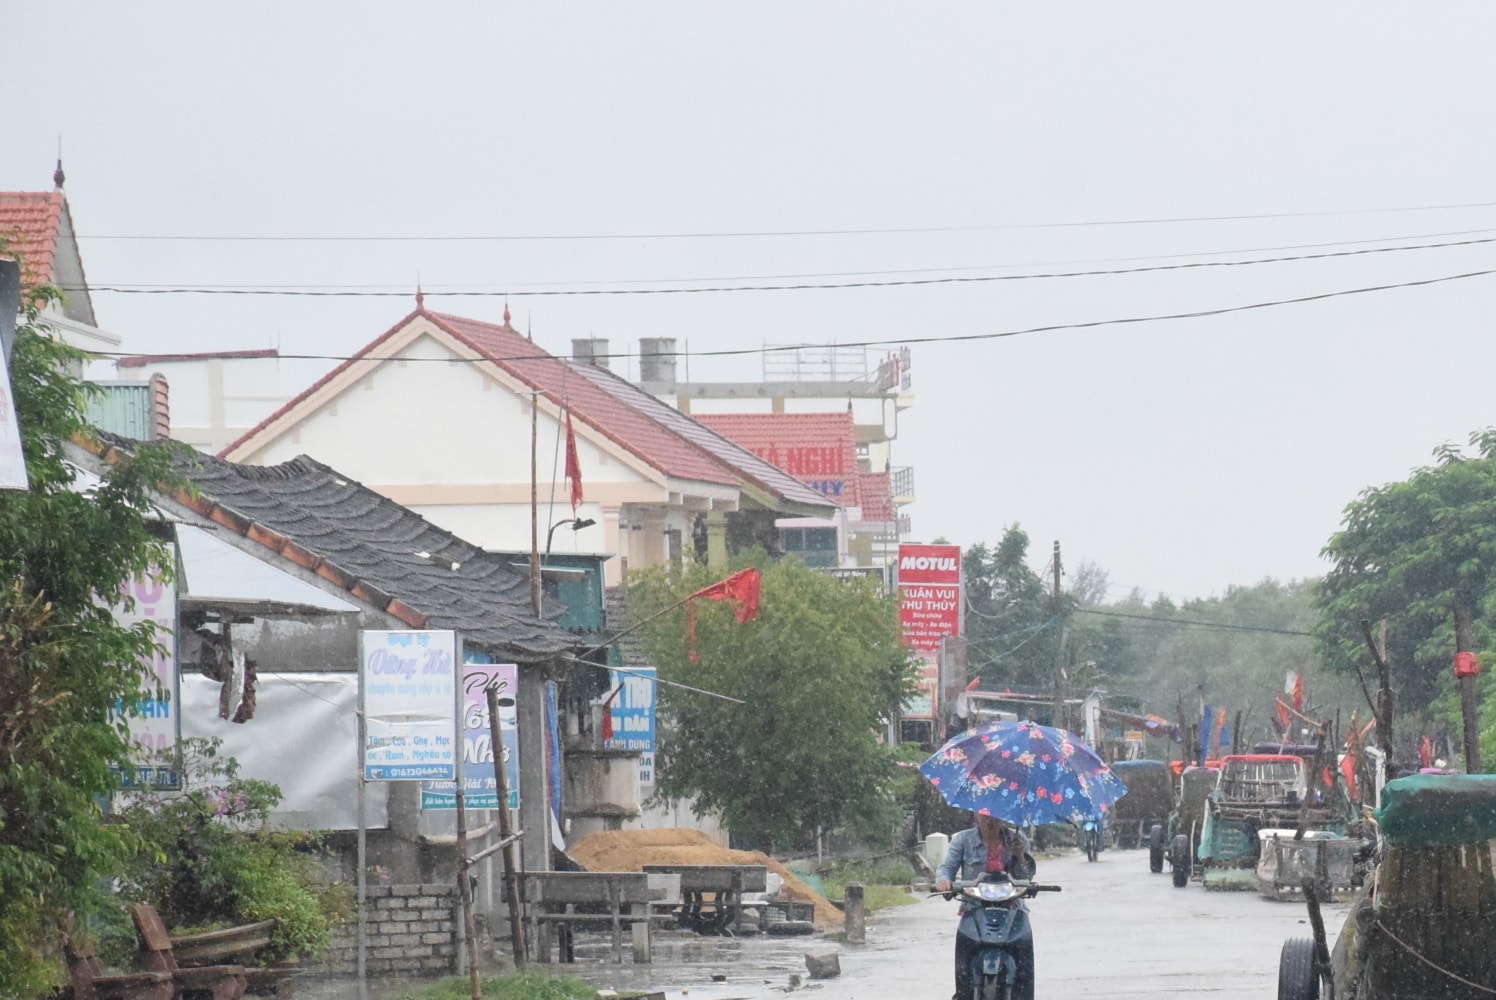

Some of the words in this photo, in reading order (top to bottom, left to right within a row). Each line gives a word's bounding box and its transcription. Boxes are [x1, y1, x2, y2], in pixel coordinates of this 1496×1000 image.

[900, 556, 957, 571] MOTUL
[903, 586, 933, 599] XUÂN
[936, 589, 955, 600] VUI
[902, 600, 923, 610] THU
